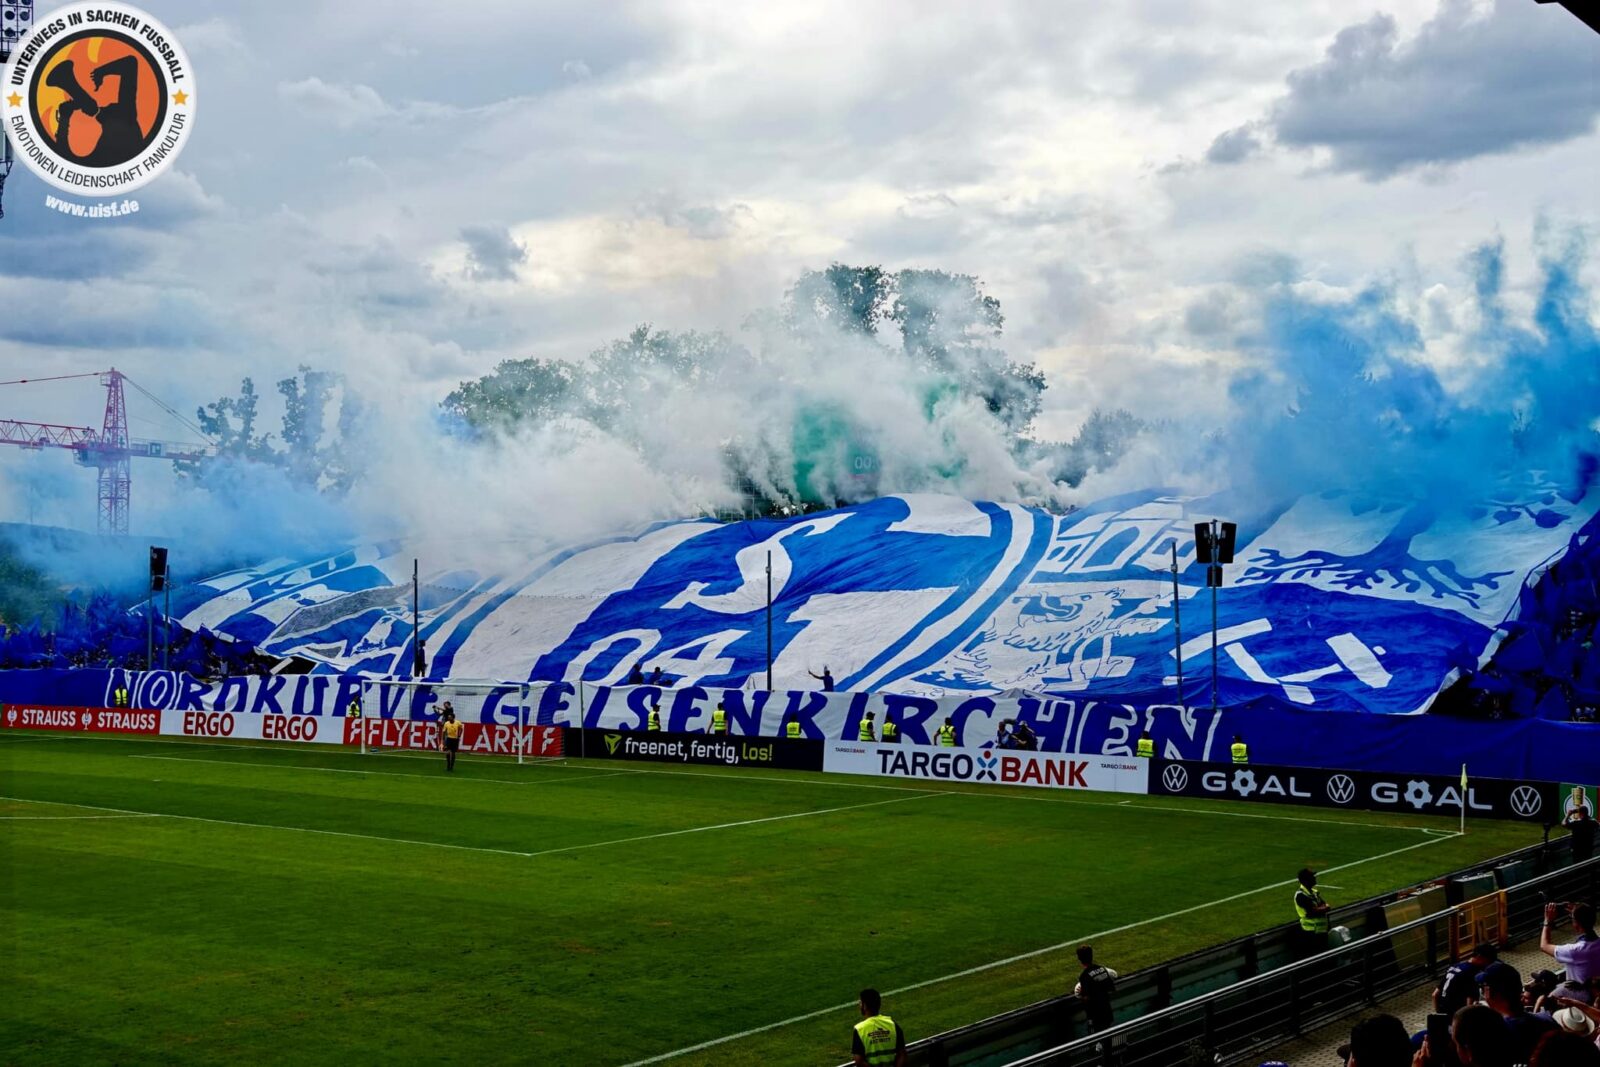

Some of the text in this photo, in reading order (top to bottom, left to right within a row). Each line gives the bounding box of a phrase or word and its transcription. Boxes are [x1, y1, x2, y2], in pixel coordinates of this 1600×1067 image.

[22, 709, 155, 730] STRAUSS STRAUSS
[183, 712, 318, 741] ERGO ERGO
[367, 719, 533, 754] FLYERLARM
[625, 737, 773, 764] freenet, fertig, los!
